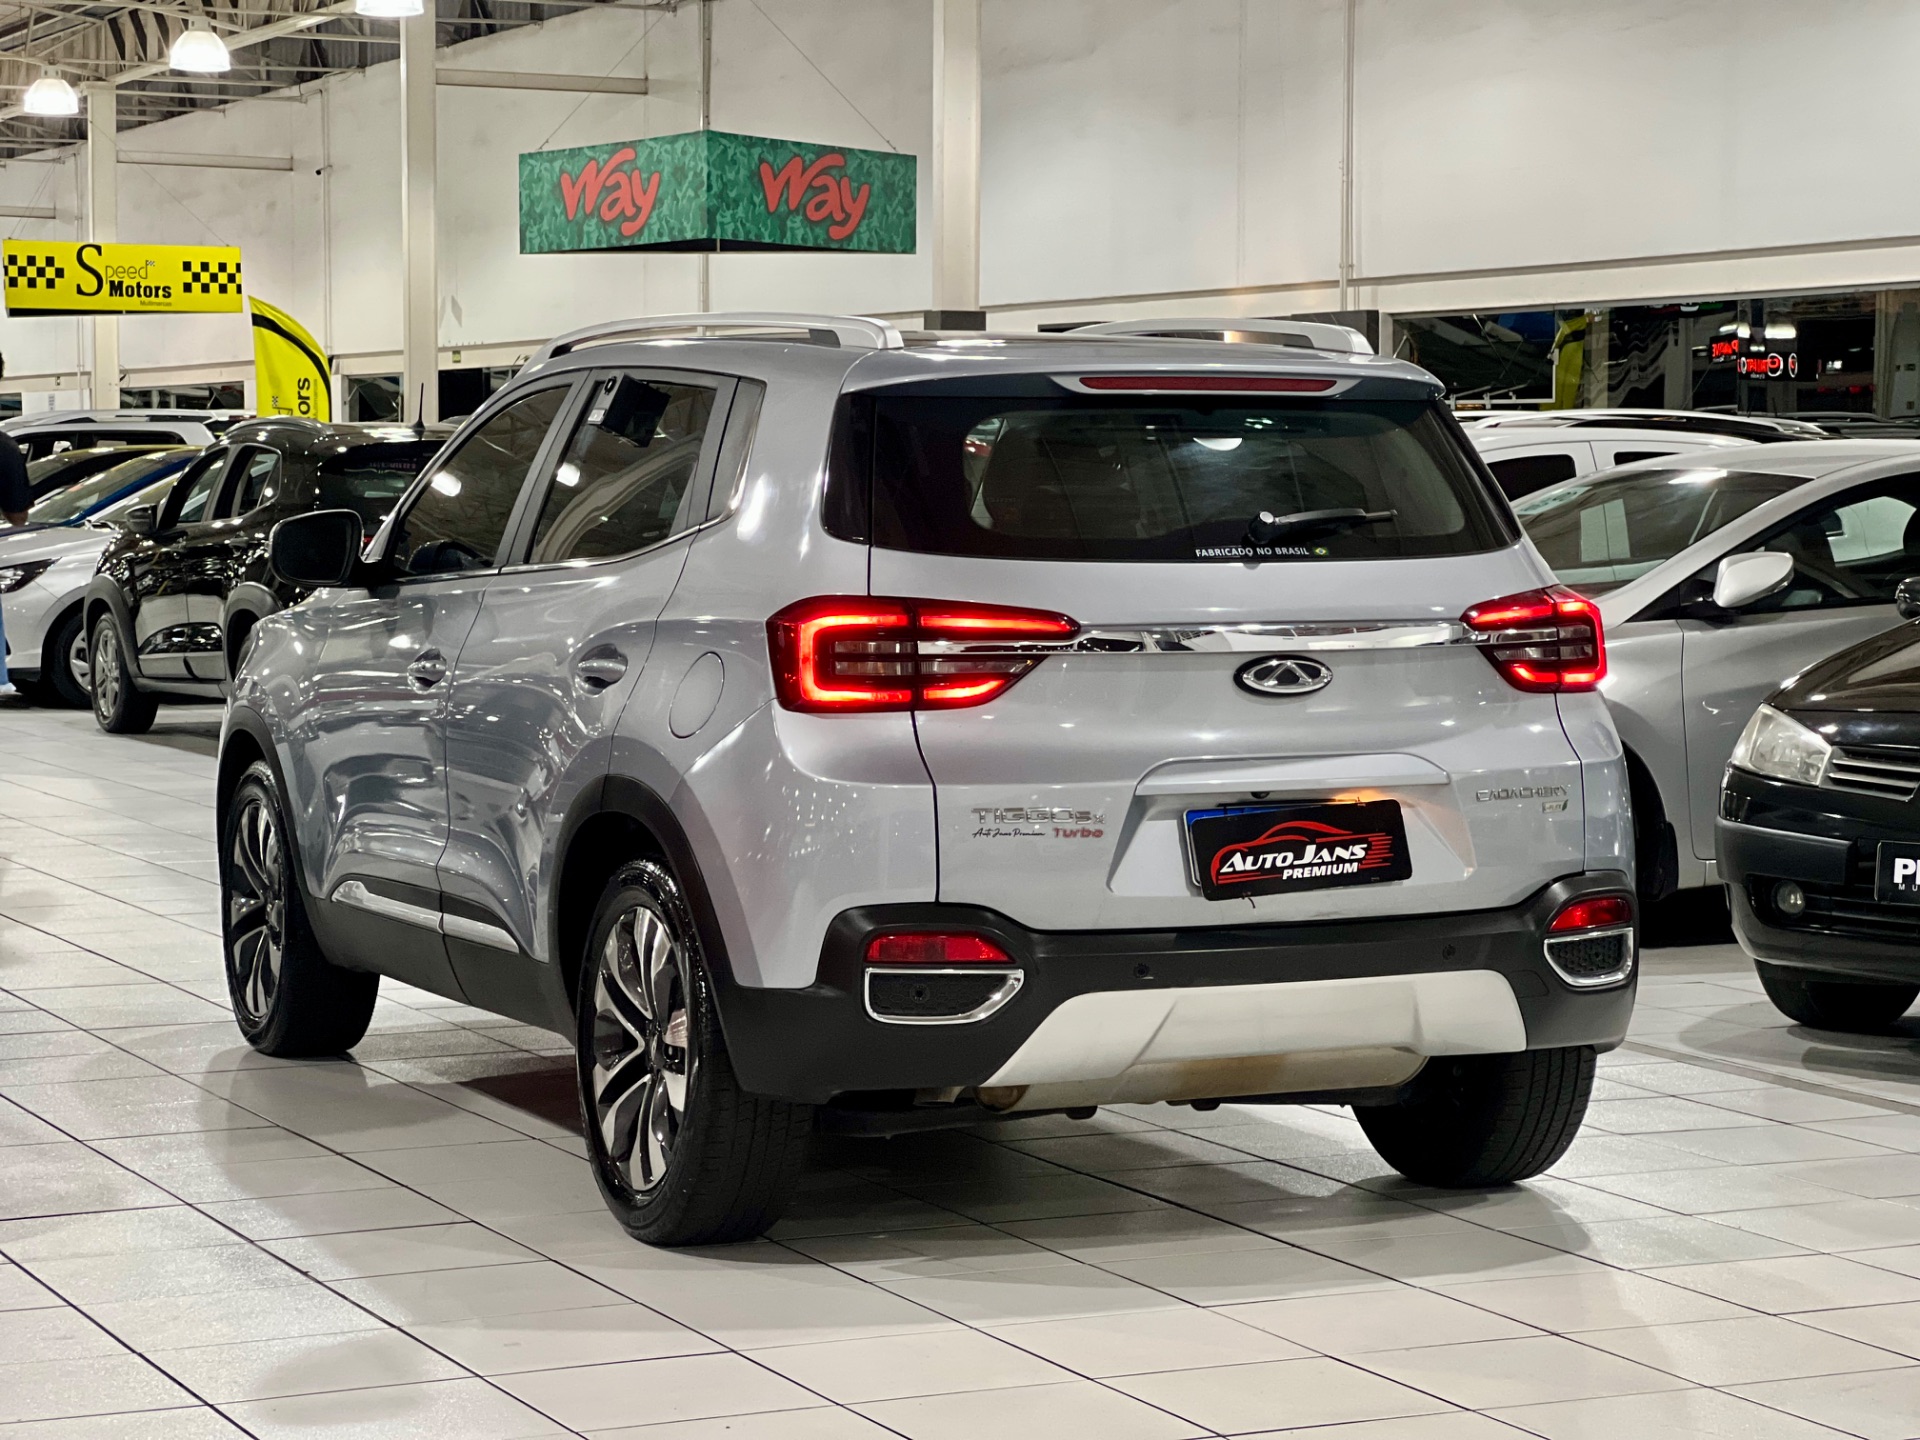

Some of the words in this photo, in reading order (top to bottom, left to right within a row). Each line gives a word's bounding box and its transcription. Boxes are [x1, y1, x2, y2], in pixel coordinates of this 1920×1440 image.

[561, 148, 660, 237] Way
[760, 153, 870, 240] Way
[76, 243, 148, 297] Speed
[109, 280, 172, 298] Motors
[1195, 547, 1253, 558] FABRICADO
[1256, 547, 1272, 556] NO
[1275, 546, 1310, 556] BRASIL
[1053, 827, 1104, 839] Turbo
[1282, 862, 1358, 880] PREMIUM
